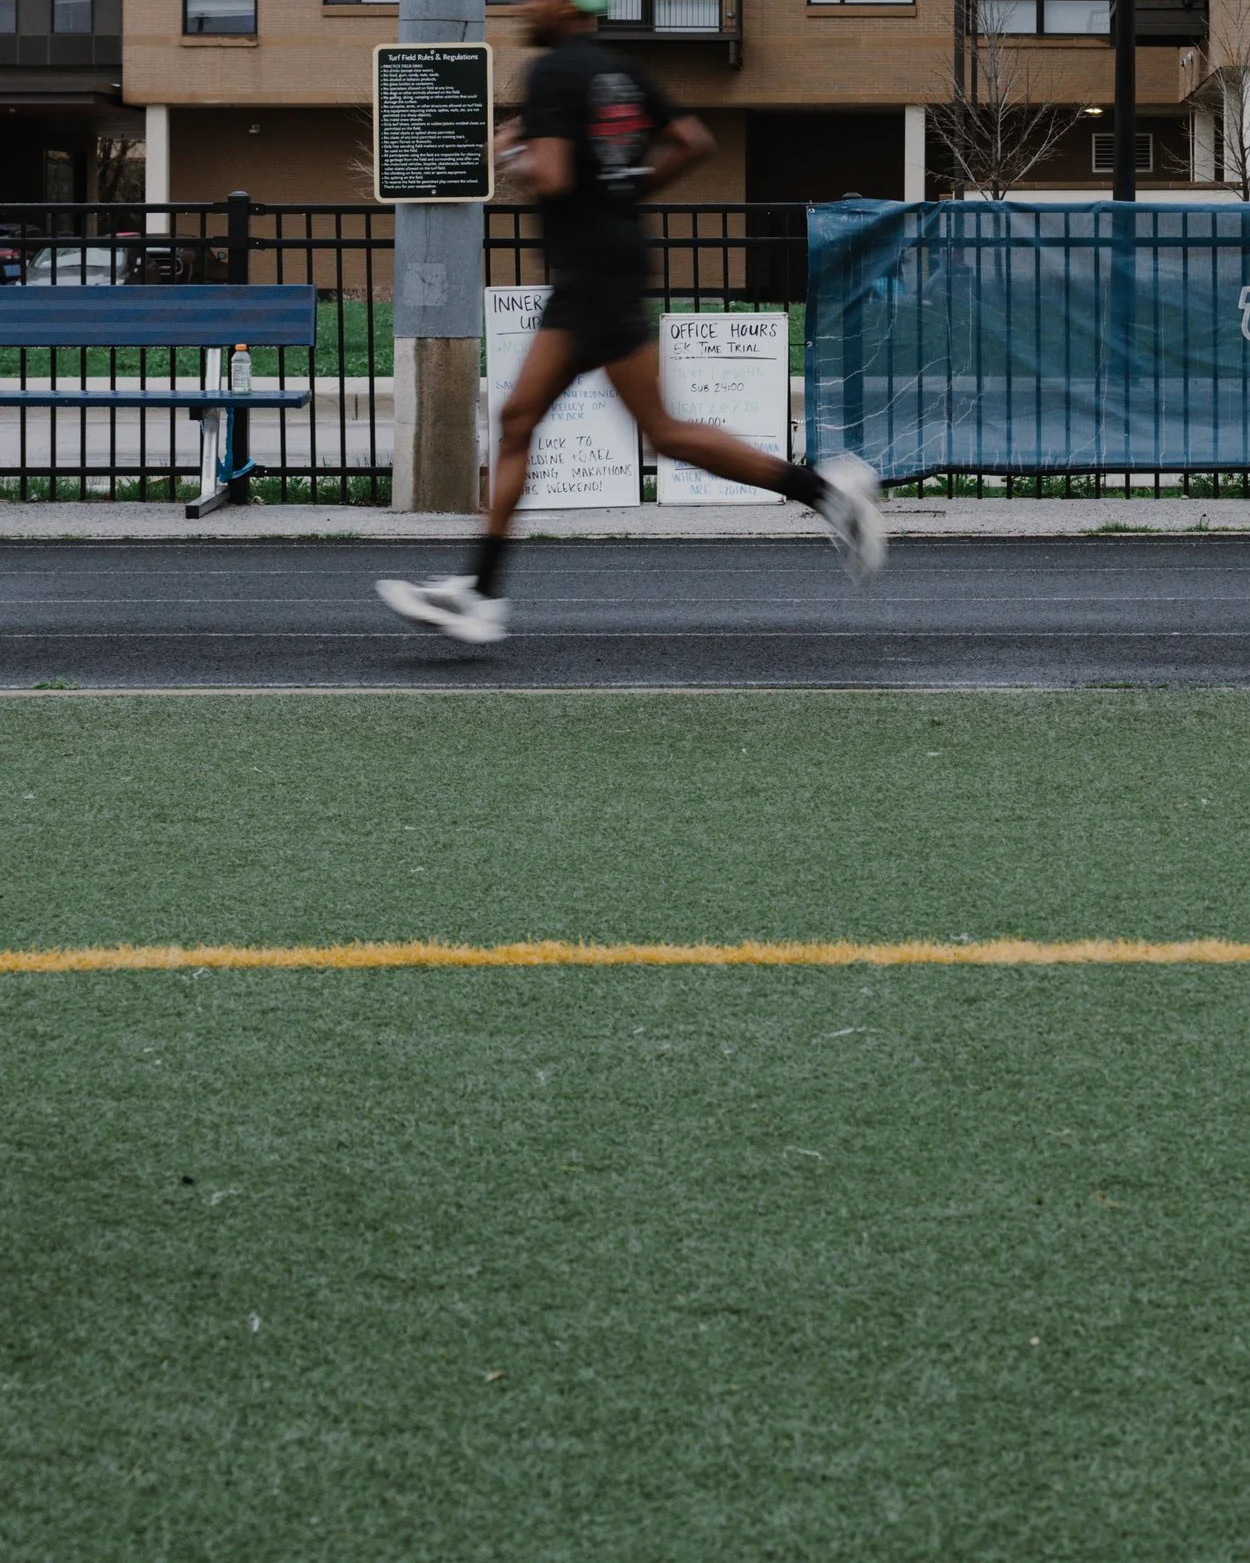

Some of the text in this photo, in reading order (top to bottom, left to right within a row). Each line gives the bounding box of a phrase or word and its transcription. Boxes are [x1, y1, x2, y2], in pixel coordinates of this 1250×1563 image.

[435, 53, 441, 61] &
[443, 53, 479, 62] Regulations
[494, 294, 544, 313] INNER
[671, 322, 778, 339] OFFICE HOURS
[699, 341, 722, 354] TIME
[728, 341, 760, 353] TRIAL
[690, 382, 745, 393] SUB 24:00
[538, 435, 592, 450] LUCK TO
[546, 480, 603, 494] WEEKEND!
